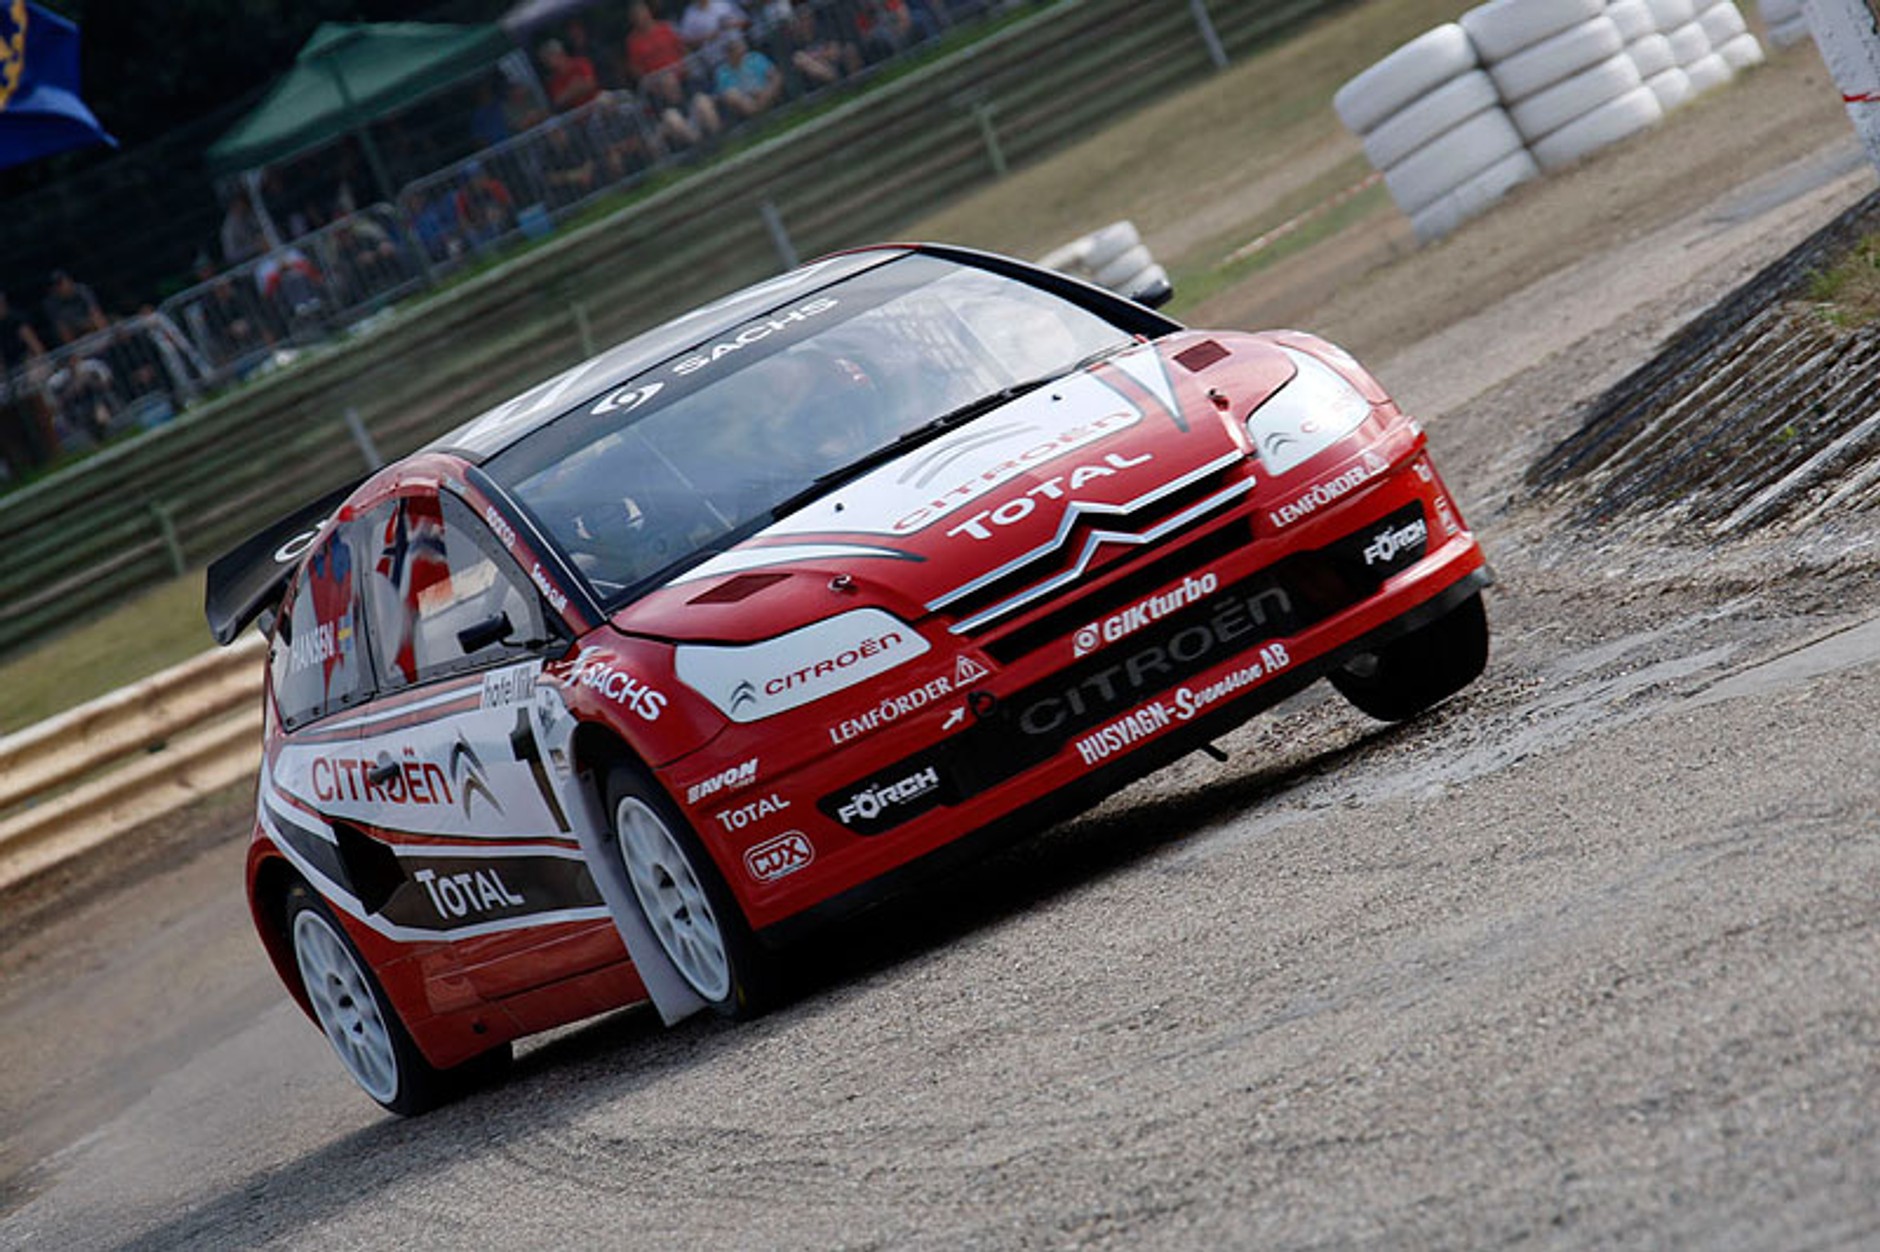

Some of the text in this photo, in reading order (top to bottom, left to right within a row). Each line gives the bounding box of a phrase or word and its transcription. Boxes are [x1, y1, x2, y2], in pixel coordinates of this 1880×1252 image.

[672, 298, 839, 376] SACHS
[946, 453, 1153, 540] TOTAL
[1269, 465, 1369, 528] LEMFÖRDER
[1363, 518, 1428, 565] FÖRCH
[764, 631, 902, 696] CITROËN
[1019, 584, 1293, 736] CITROËN
[1259, 643, 1290, 673] AB
[581, 661, 669, 721] SACHS
[829, 675, 953, 745] LEMFÖRDER
[715, 793, 791, 833] TOTAL
[837, 766, 939, 824] FÖRCH
[413, 867, 525, 921] TOTAL
